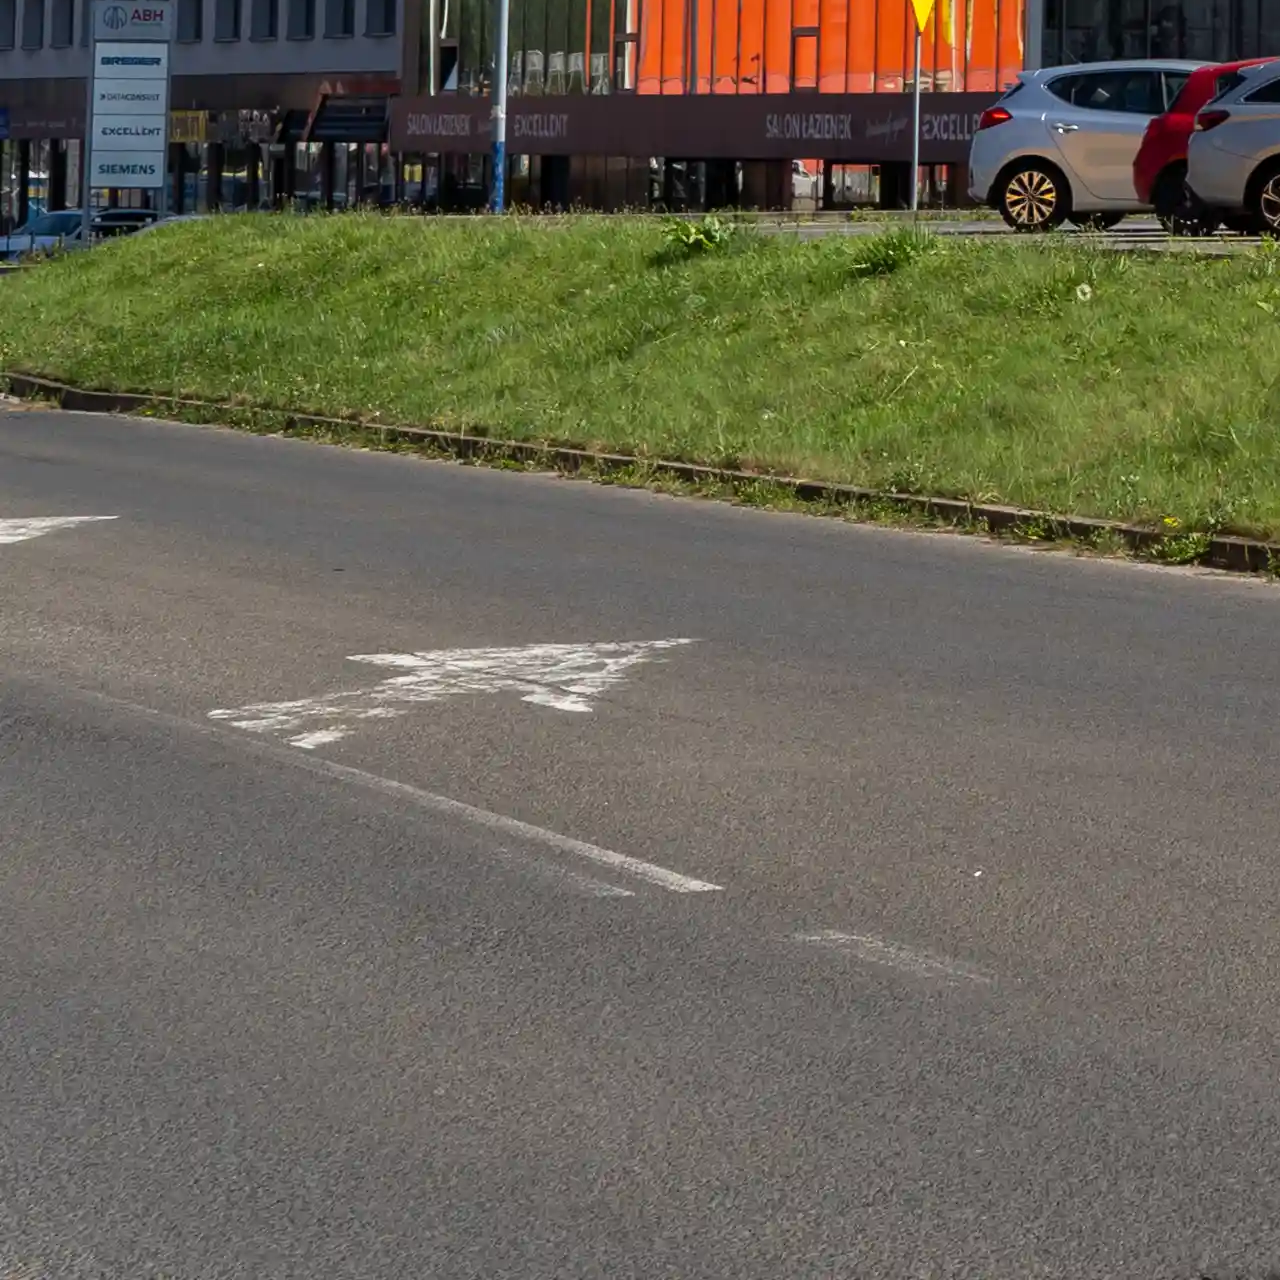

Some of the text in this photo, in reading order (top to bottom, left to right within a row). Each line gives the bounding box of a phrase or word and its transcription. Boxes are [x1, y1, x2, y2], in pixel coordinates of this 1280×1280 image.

[131, 8, 164, 22] ABH
[101, 127, 161, 137] EXCELLENT
[98, 164, 156, 175] SIEMENS
